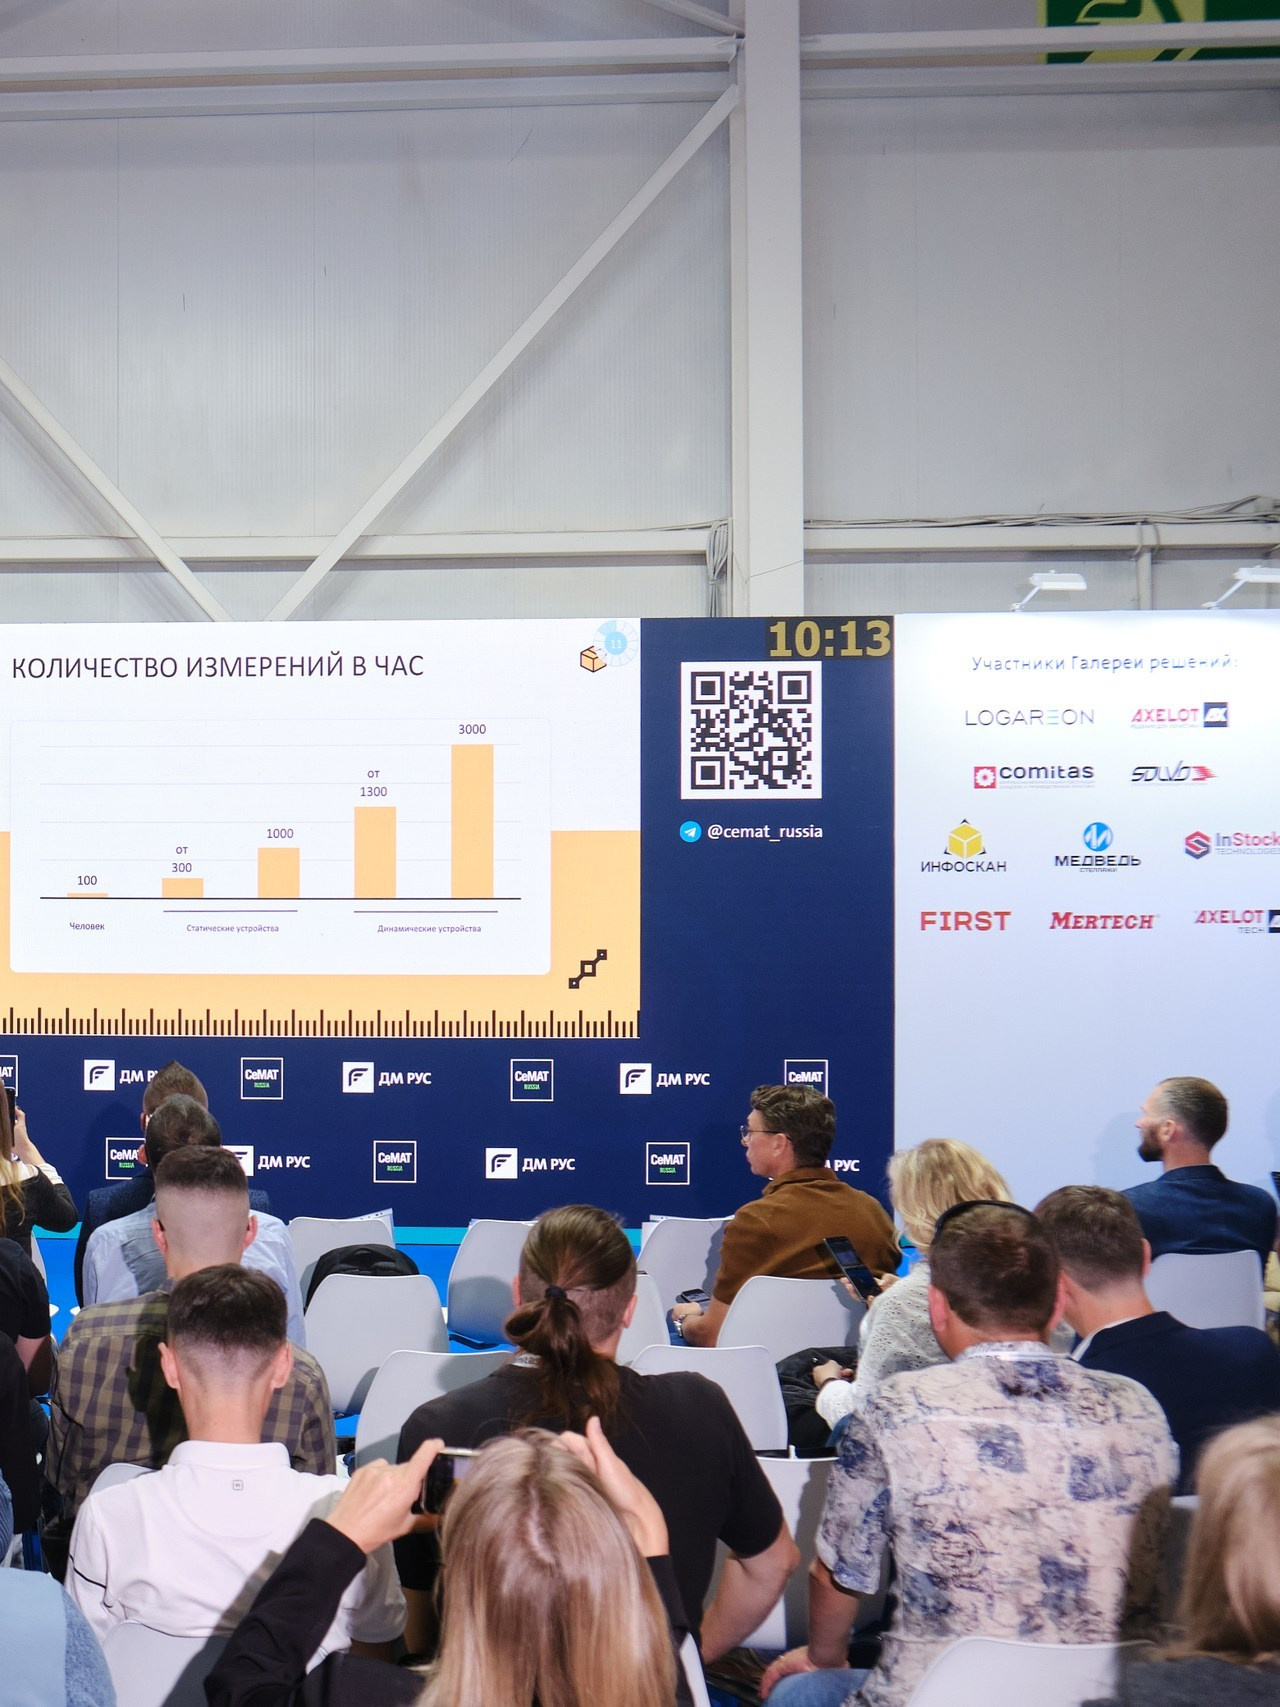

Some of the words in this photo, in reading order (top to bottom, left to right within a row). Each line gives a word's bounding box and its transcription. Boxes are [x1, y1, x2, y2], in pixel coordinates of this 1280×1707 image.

[770, 620, 891, 657] 10:13
[12, 657, 178, 679] КОЛИЧЕСТВО
[187, 650, 343, 677] ИЗМЕРЕНИЙ
[353, 656, 367, 676] В
[375, 655, 424, 676] ЧАС
[971, 656, 1065, 671] Участники
[1071, 655, 1143, 673] Галереи
[965, 709, 1095, 726] LOGAREON
[1131, 708, 1200, 722] AXELOT
[459, 723, 487, 735] 3000
[999, 766, 1095, 779] comitas
[360, 786, 388, 797] 1300
[266, 828, 294, 839] 1000
[707, 824, 823, 842] @cemat_russia
[1054, 855, 1141, 866] МЕДВЕДЬ
[171, 862, 192, 873] 300
[920, 861, 1007, 873] ИНФОСКАН
[77, 875, 98, 886] 100
[920, 911, 1012, 931] FIRST
[1195, 910, 1264, 924] AXELOT
[69, 922, 105, 931] Человек
[186, 924, 235, 932] Статические
[236, 924, 280, 934] устройства
[376, 924, 436, 934] Динамические
[438, 924, 482, 934] устройства
[119, 1069, 144, 1084] ДМ
[244, 1069, 280, 1081] CeMAT
[378, 1072, 404, 1087] ДМ
[407, 1072, 432, 1085] РУС
[514, 1070, 550, 1082] CeMAT
[656, 1073, 682, 1087] ДМ
[685, 1073, 710, 1086] РУС
[788, 1071, 824, 1083] CeMAT
[258, 1156, 283, 1169] ДМ
[286, 1156, 311, 1168] РУС
[378, 1152, 412, 1164] CeMAT
[650, 1154, 685, 1166] CeMAT
[522, 1158, 548, 1172] ДМ
[551, 1158, 576, 1171] РУС
[834, 1159, 860, 1172] РУС
